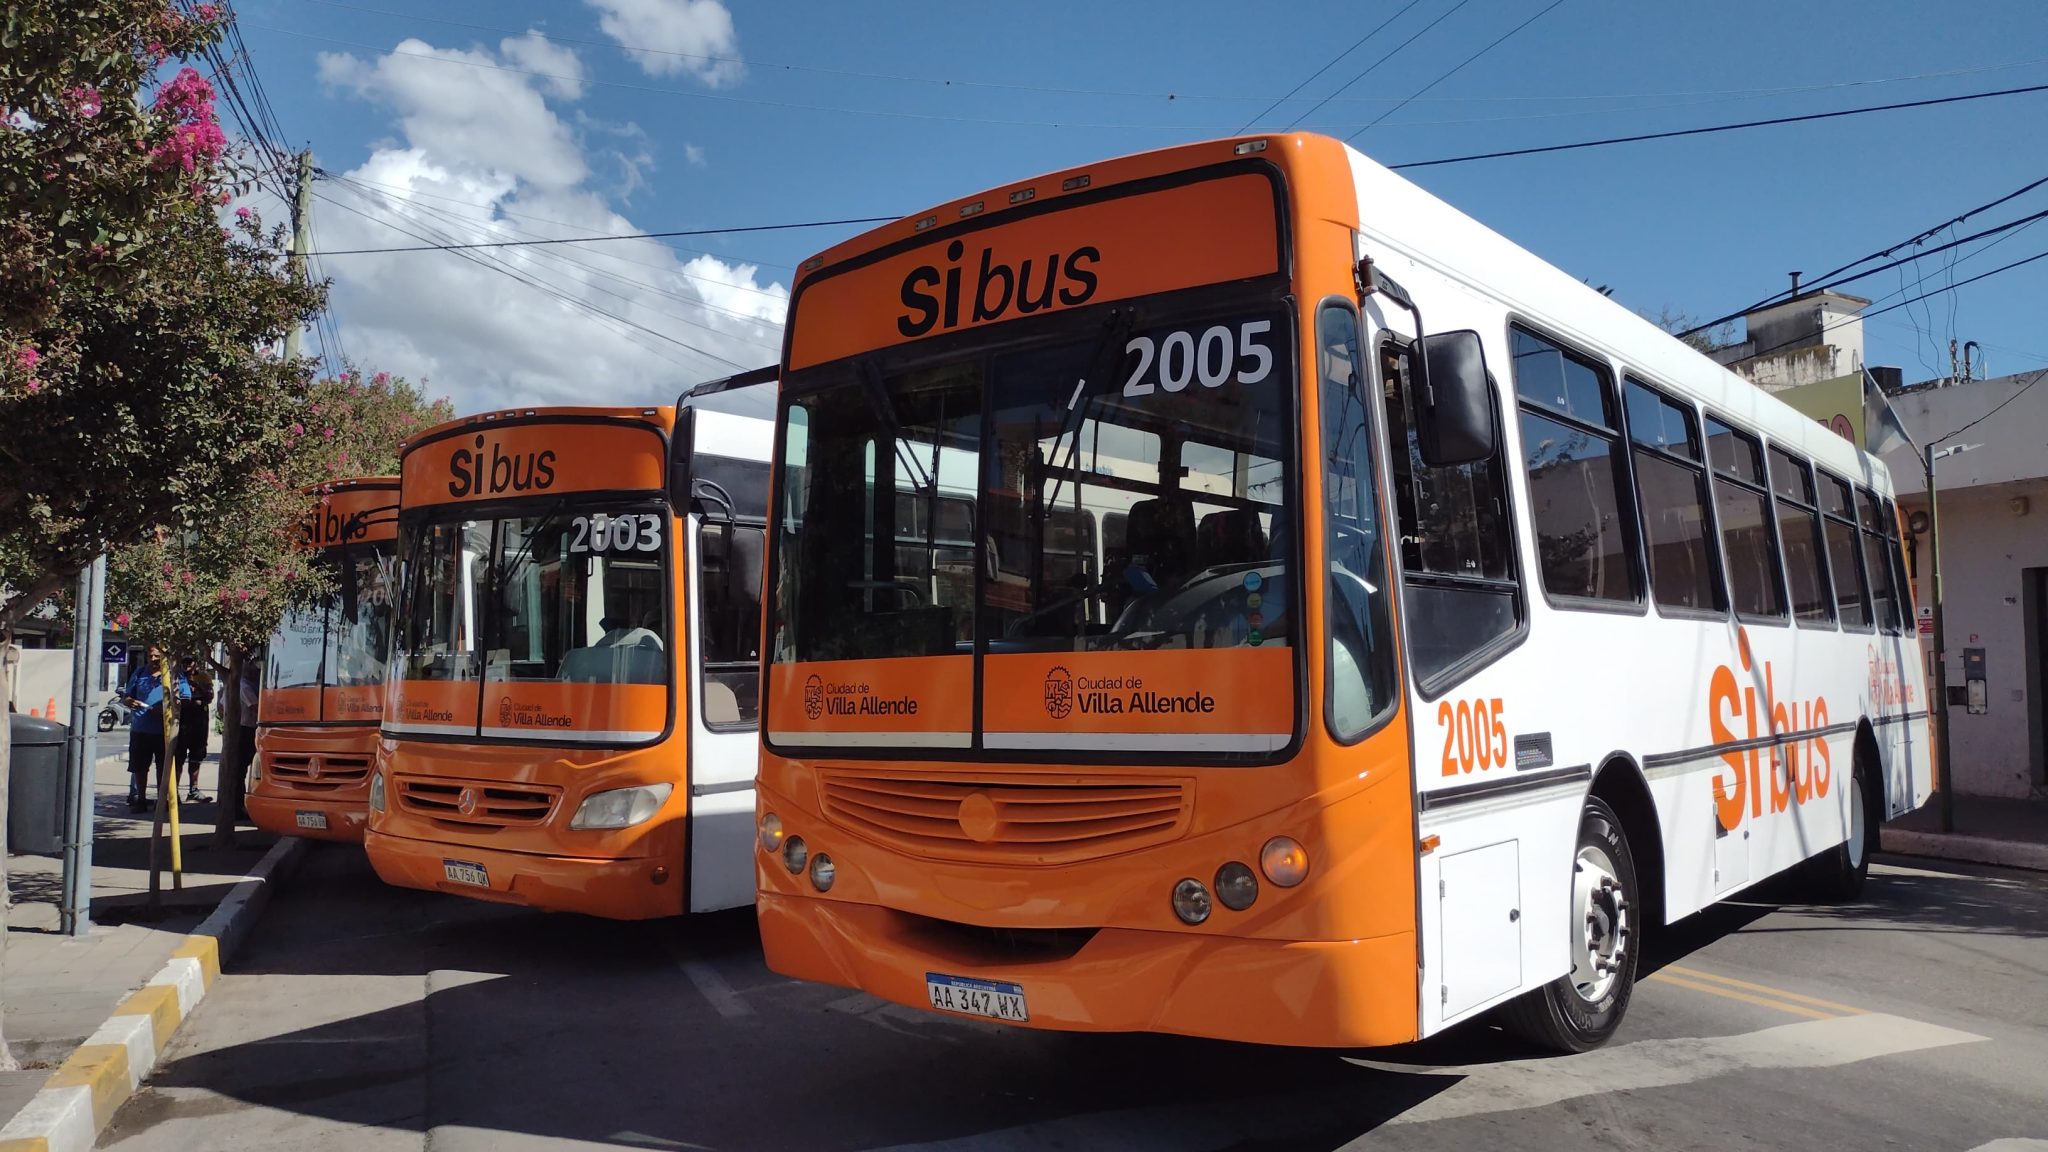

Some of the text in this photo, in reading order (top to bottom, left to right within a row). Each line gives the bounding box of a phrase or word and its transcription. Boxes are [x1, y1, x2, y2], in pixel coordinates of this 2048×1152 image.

[1122, 319, 1274, 398] 2005
[569, 513, 662, 554] 2003
[826, 682, 870, 695] Ciudad de
[1077, 676, 1143, 690] Ciudad de
[826, 695, 918, 716] Villa Allende
[1077, 691, 1216, 714] Villa Allende
[406, 708, 453, 722] Villa Allende
[513, 712, 572, 727] Villa Allende
[1438, 697, 1508, 777] 2005
[447, 866, 459, 880] AA
[460, 868, 476, 883] 756
[934, 985, 955, 1009] AA
[958, 988, 991, 1013] 347
